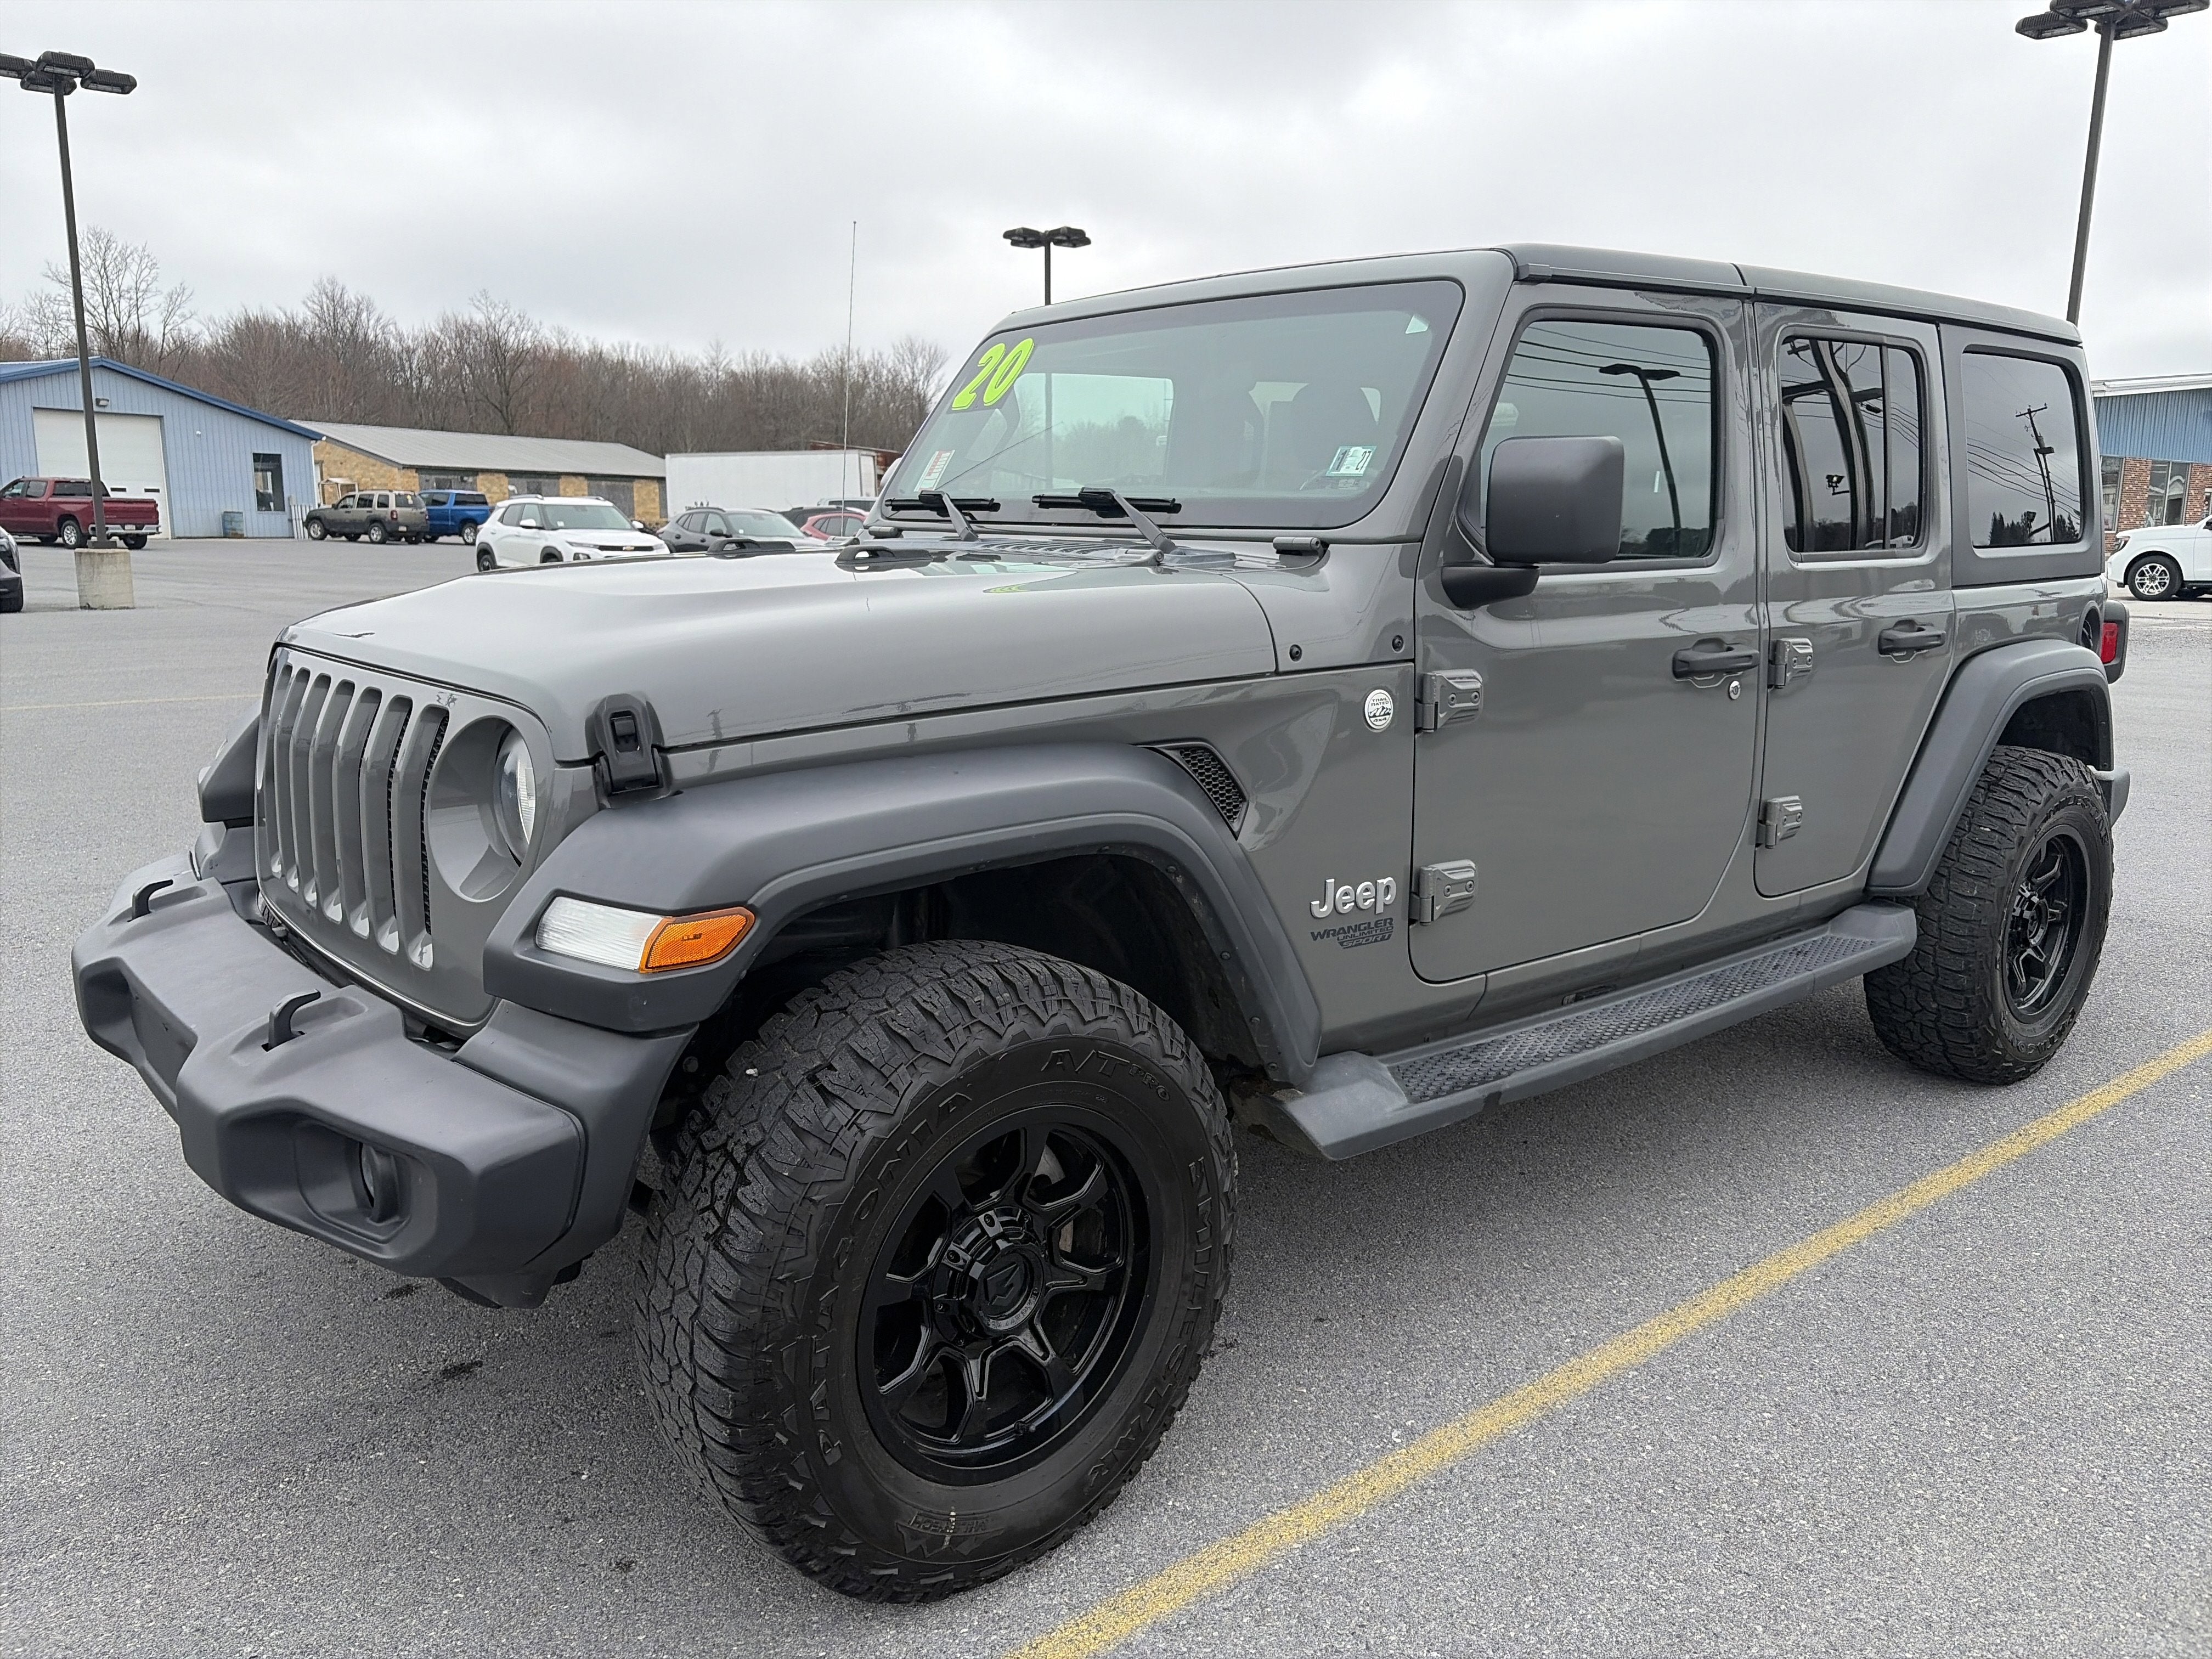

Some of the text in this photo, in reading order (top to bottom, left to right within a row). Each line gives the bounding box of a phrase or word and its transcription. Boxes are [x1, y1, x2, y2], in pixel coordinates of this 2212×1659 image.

[952, 338, 1034, 410] 20
[1355, 450, 1372, 472] 27
[1310, 877, 1397, 918] Jeep
[1310, 917, 1393, 941] WRANGLER
[1336, 926, 1394, 941] UNLIMITED
[1341, 933, 1392, 949] SPORT
[809, 1092, 972, 1467] PATAGONIA
[1040, 1049, 1130, 1078] A/T
[1128, 1063, 1171, 1102] PRO
[1087, 1196, 1214, 1488] MILESTAR
